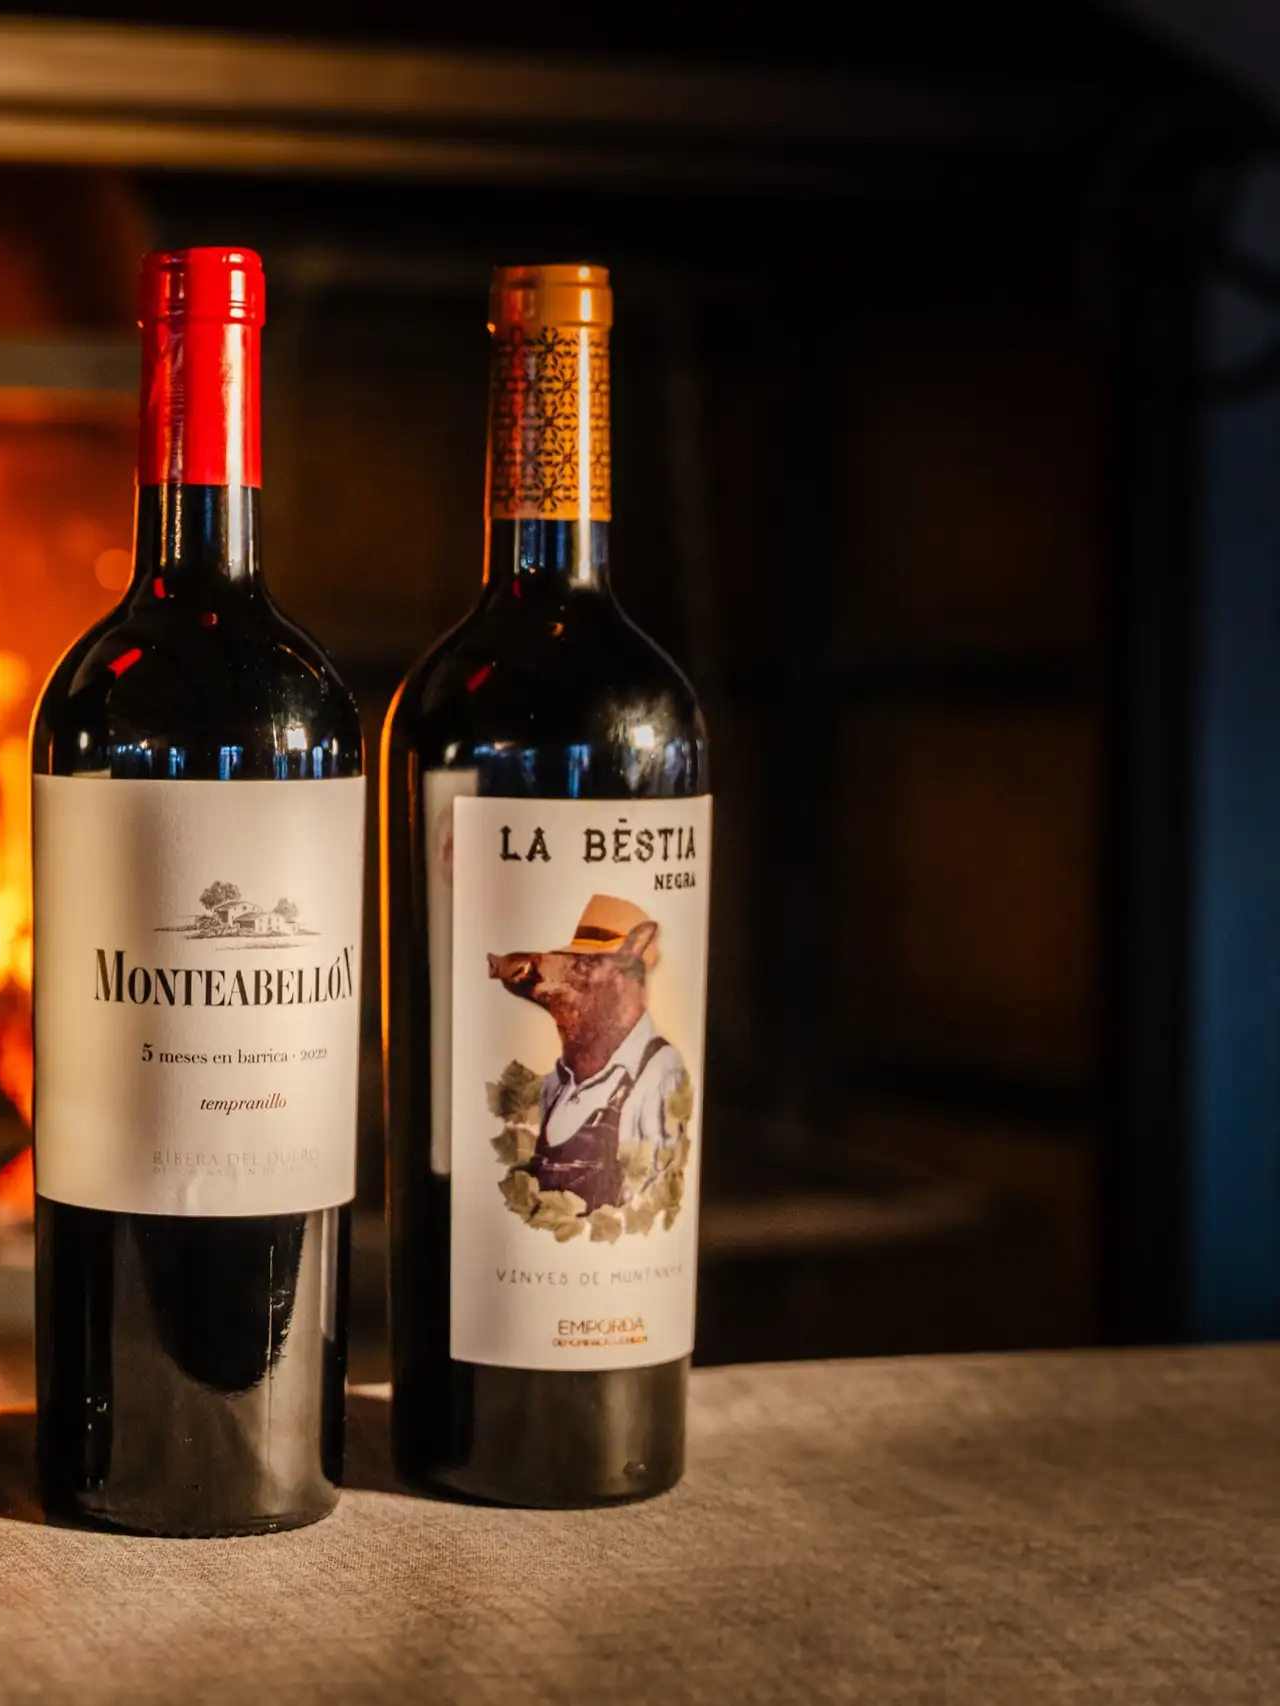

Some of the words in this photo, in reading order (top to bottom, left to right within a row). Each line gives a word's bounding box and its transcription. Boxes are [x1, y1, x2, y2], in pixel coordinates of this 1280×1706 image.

[499, 825, 552, 863] LA
[653, 871, 697, 891] NEGRA
[93, 944, 355, 1008] MONTEABELLÓN
[141, 1042, 153, 1063] 5
[159, 1051, 208, 1065] meses
[212, 1051, 233, 1065] en
[238, 1048, 288, 1065] barrica
[300, 1047, 328, 1062] 2022
[199, 1092, 287, 1116] tempranillo
[496, 1267, 569, 1286] VINYES
[579, 1270, 600, 1286] DE
